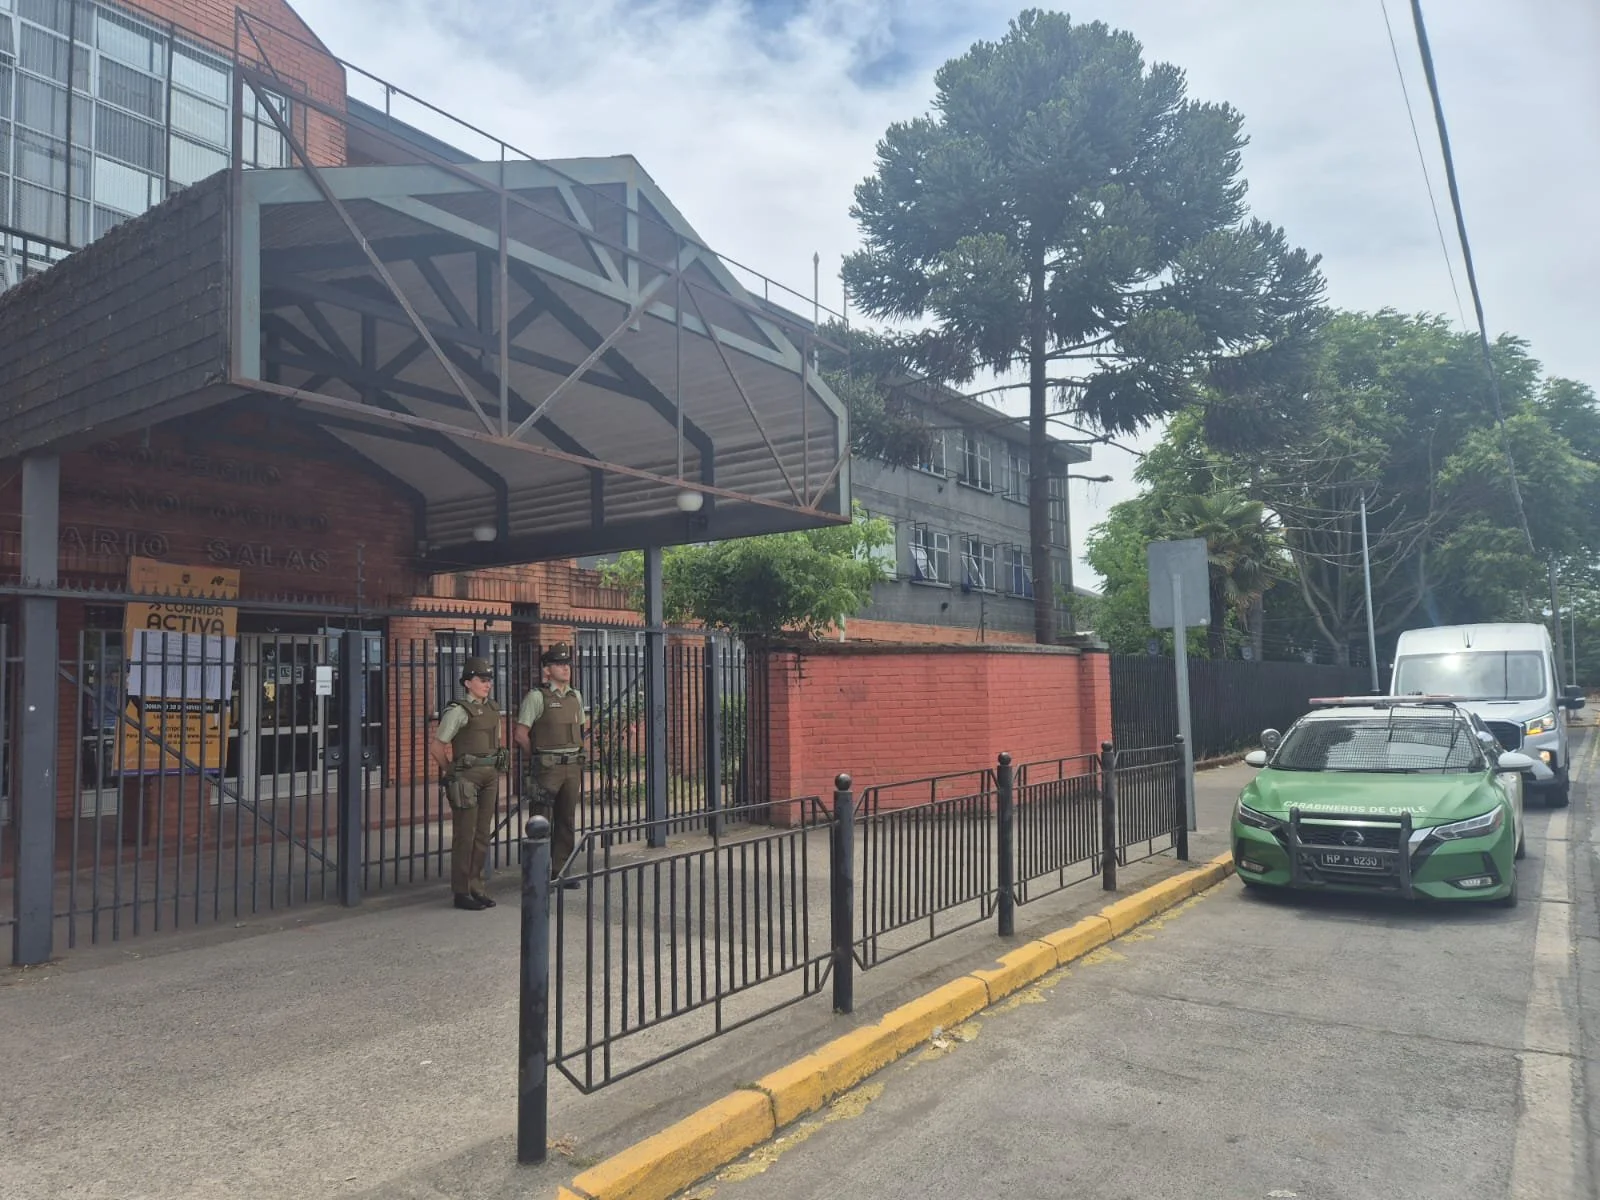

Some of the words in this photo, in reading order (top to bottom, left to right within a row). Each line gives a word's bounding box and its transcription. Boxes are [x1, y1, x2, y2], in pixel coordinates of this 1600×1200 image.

[58, 525, 170, 558] ARIO
[206, 538, 331, 573] SALAS
[146, 613, 225, 635] ACTIVA
[1283, 800, 1365, 813] CARABINEROS
[1389, 805, 1427, 814] CHILE
